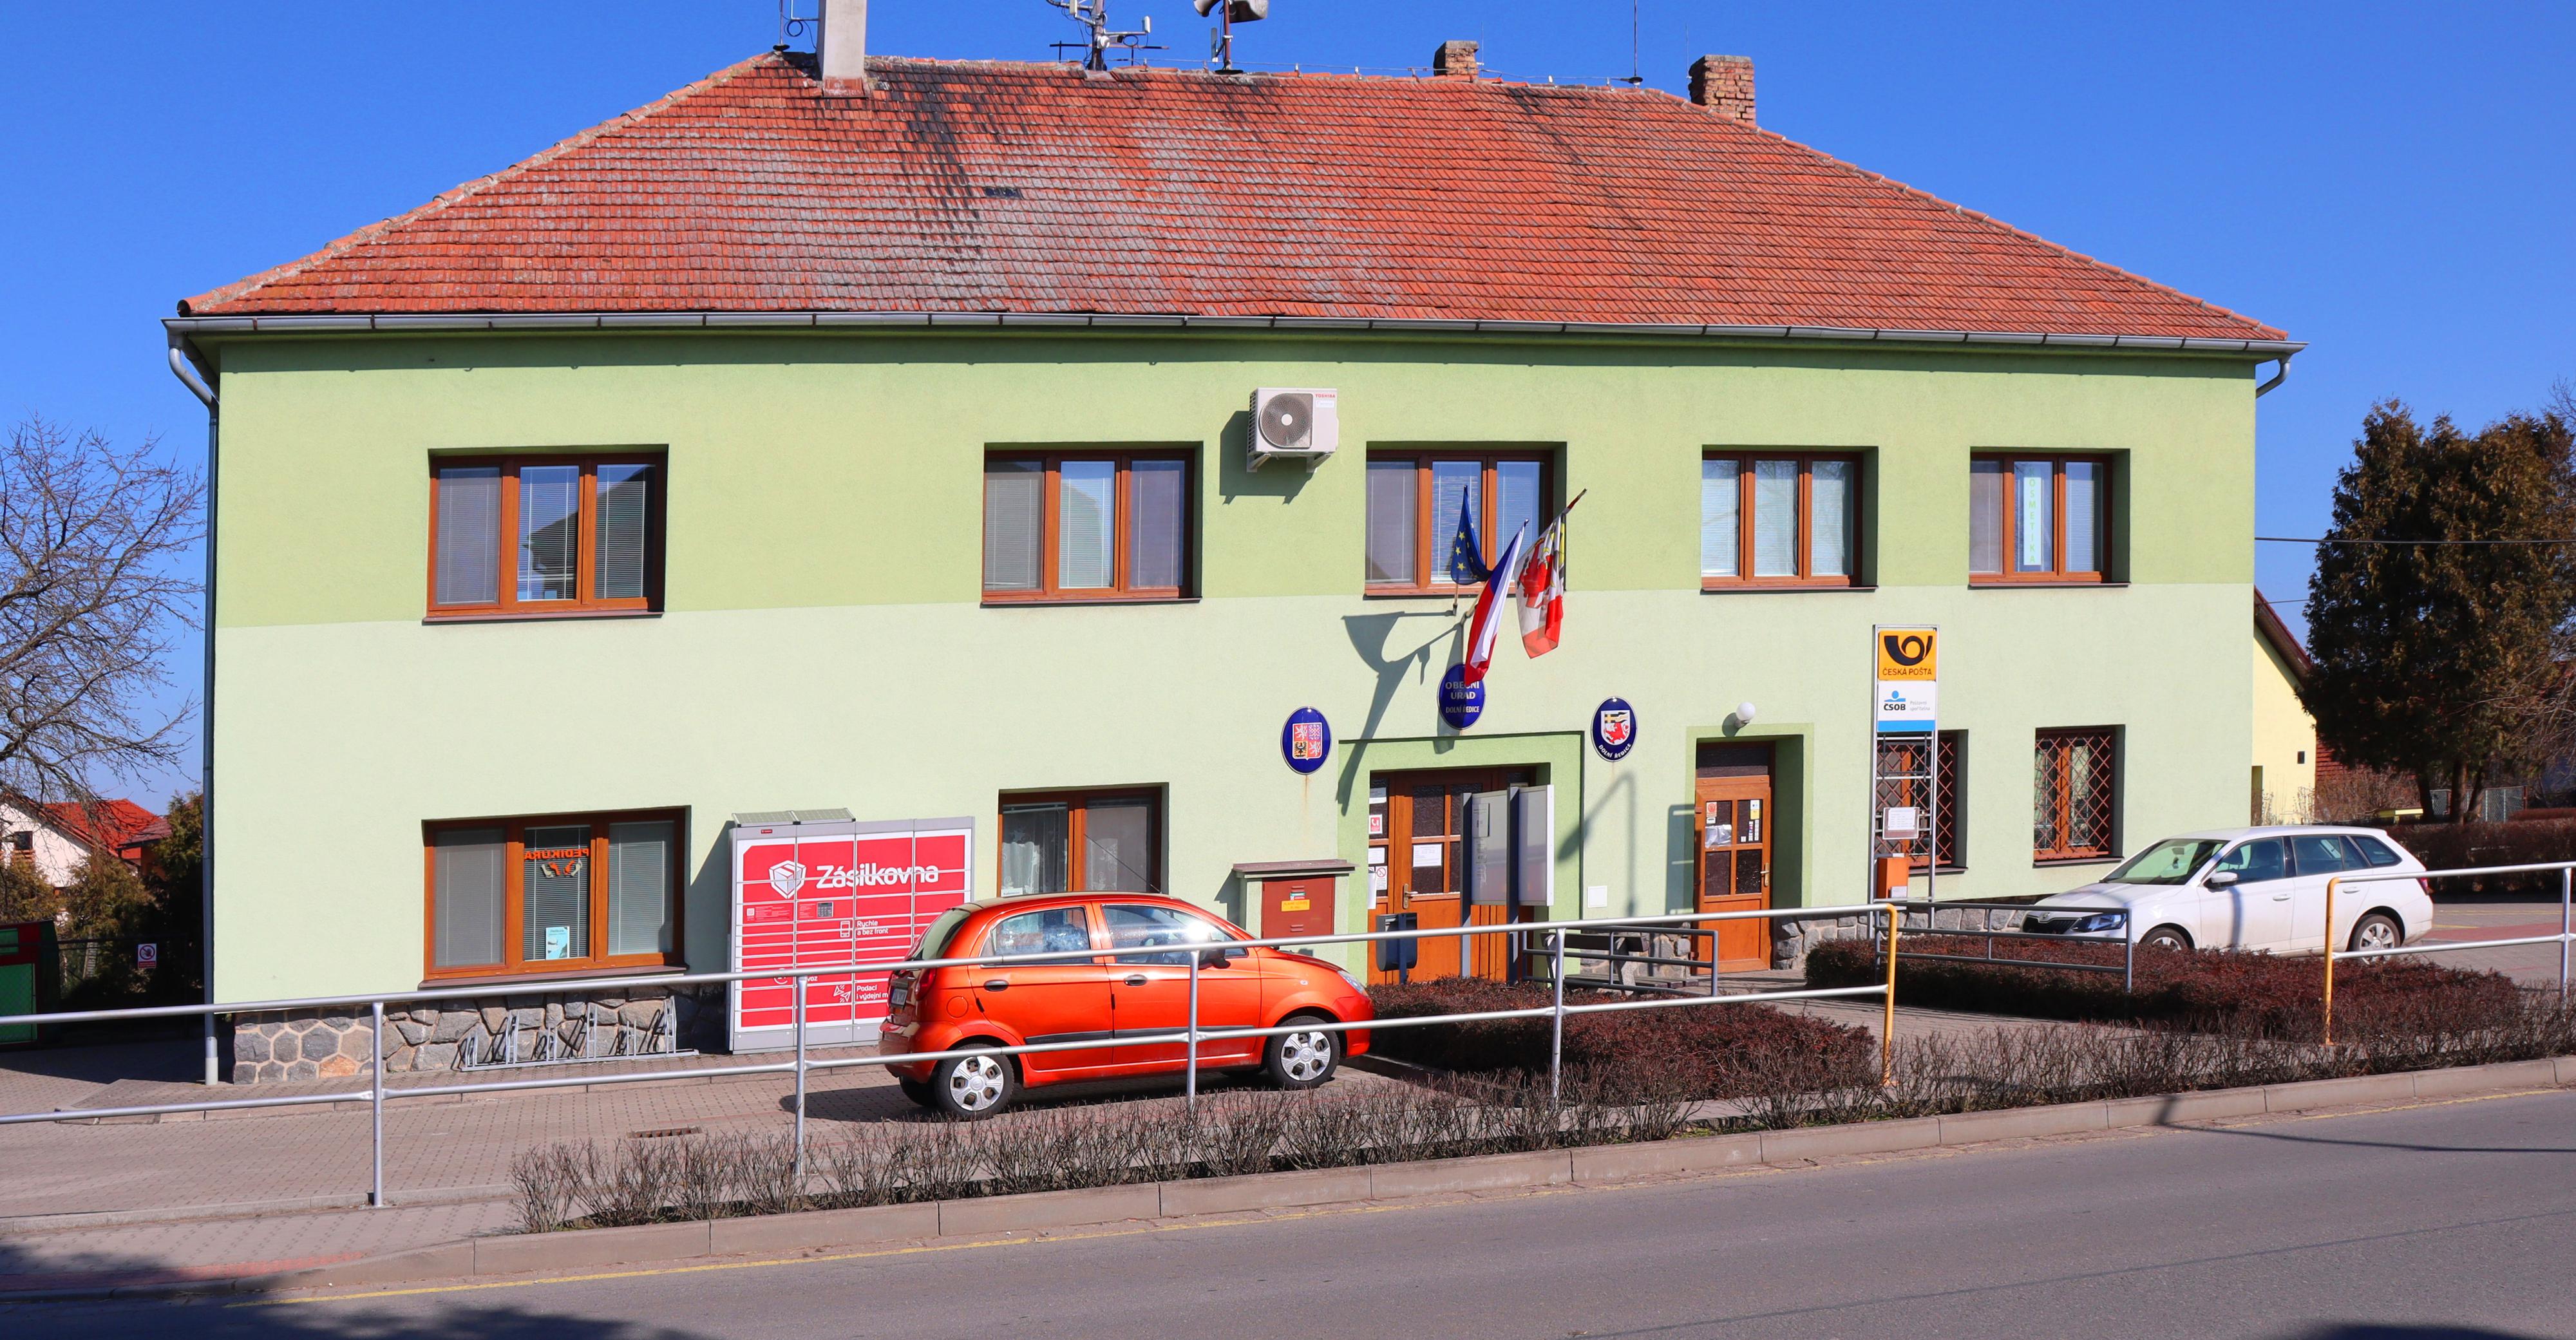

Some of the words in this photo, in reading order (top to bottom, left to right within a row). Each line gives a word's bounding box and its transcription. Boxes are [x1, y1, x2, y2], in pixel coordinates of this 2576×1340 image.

[1882, 667, 1907, 675] ČESKÁ
[1908, 667, 1932, 675] POŠTA
[1450, 690, 1476, 699] ÚŘAD
[1446, 704, 1463, 713] DOLNÍ
[1884, 703, 1906, 711] ČSOB
[1598, 744, 1613, 758] DOLNÍ
[1614, 742, 1631, 759] ŘEDICE
[816, 862, 938, 889] Zásilkovna
[859, 992, 882, 1001] výdejní
